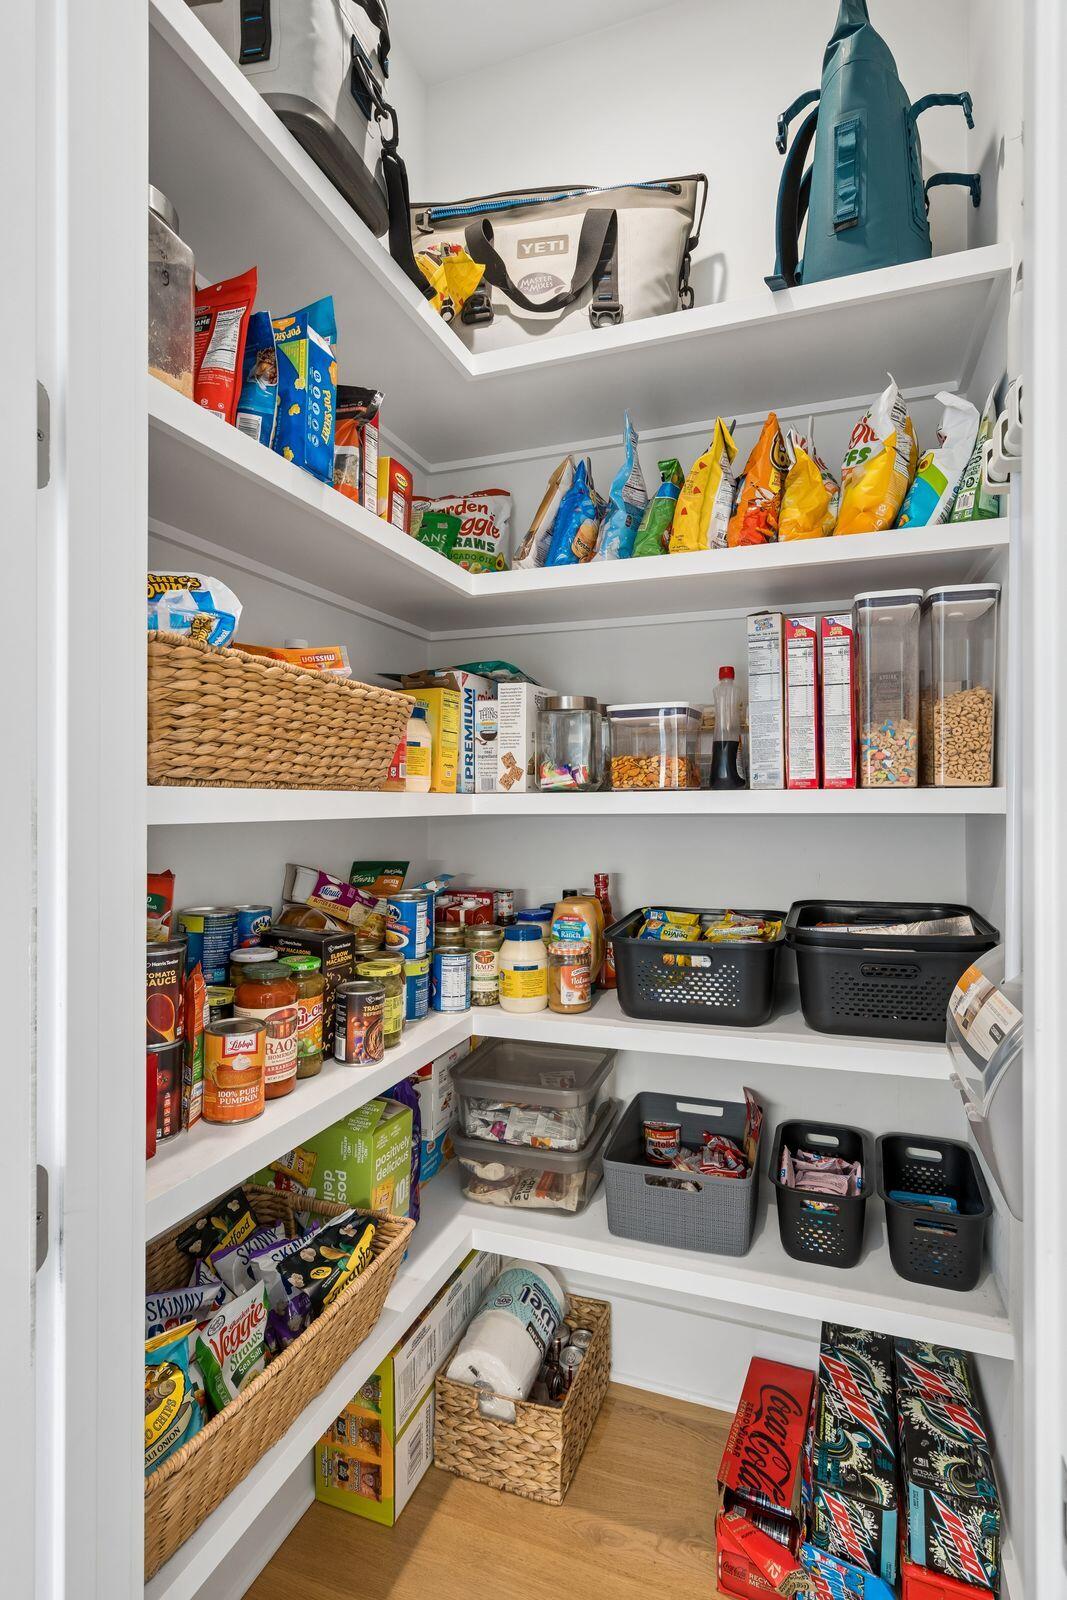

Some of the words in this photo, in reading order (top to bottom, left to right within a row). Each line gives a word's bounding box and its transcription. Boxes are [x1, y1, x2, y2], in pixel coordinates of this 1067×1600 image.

[521, 240, 564, 254] YETI
[459, 514, 500, 539] ggie
[455, 537, 495, 553] RAWS
[147, 573, 201, 588] ture's
[301, 654, 335, 664] mission
[479, 709, 498, 719] THINS
[464, 688, 473, 779] PREMIUM
[561, 931, 580, 939] Ranch
[331, 950, 348, 959] ELBOW
[229, 1039, 253, 1051] Libby's
[220, 1093, 258, 1105] PUMPKIN
[240, 1086, 259, 1097] PURE
[376, 1135, 411, 1171] positively
[377, 1150, 409, 1182] delicious
[209, 1302, 267, 1368] Veggie
[230, 1329, 263, 1373] Straws
[239, 1358, 252, 1375] Sea
[250, 1349, 263, 1363] Salt
[153, 1399, 177, 1432] CHIPS
[157, 1426, 181, 1451] ONION
[726, 1418, 742, 1454] CAFFEINE
